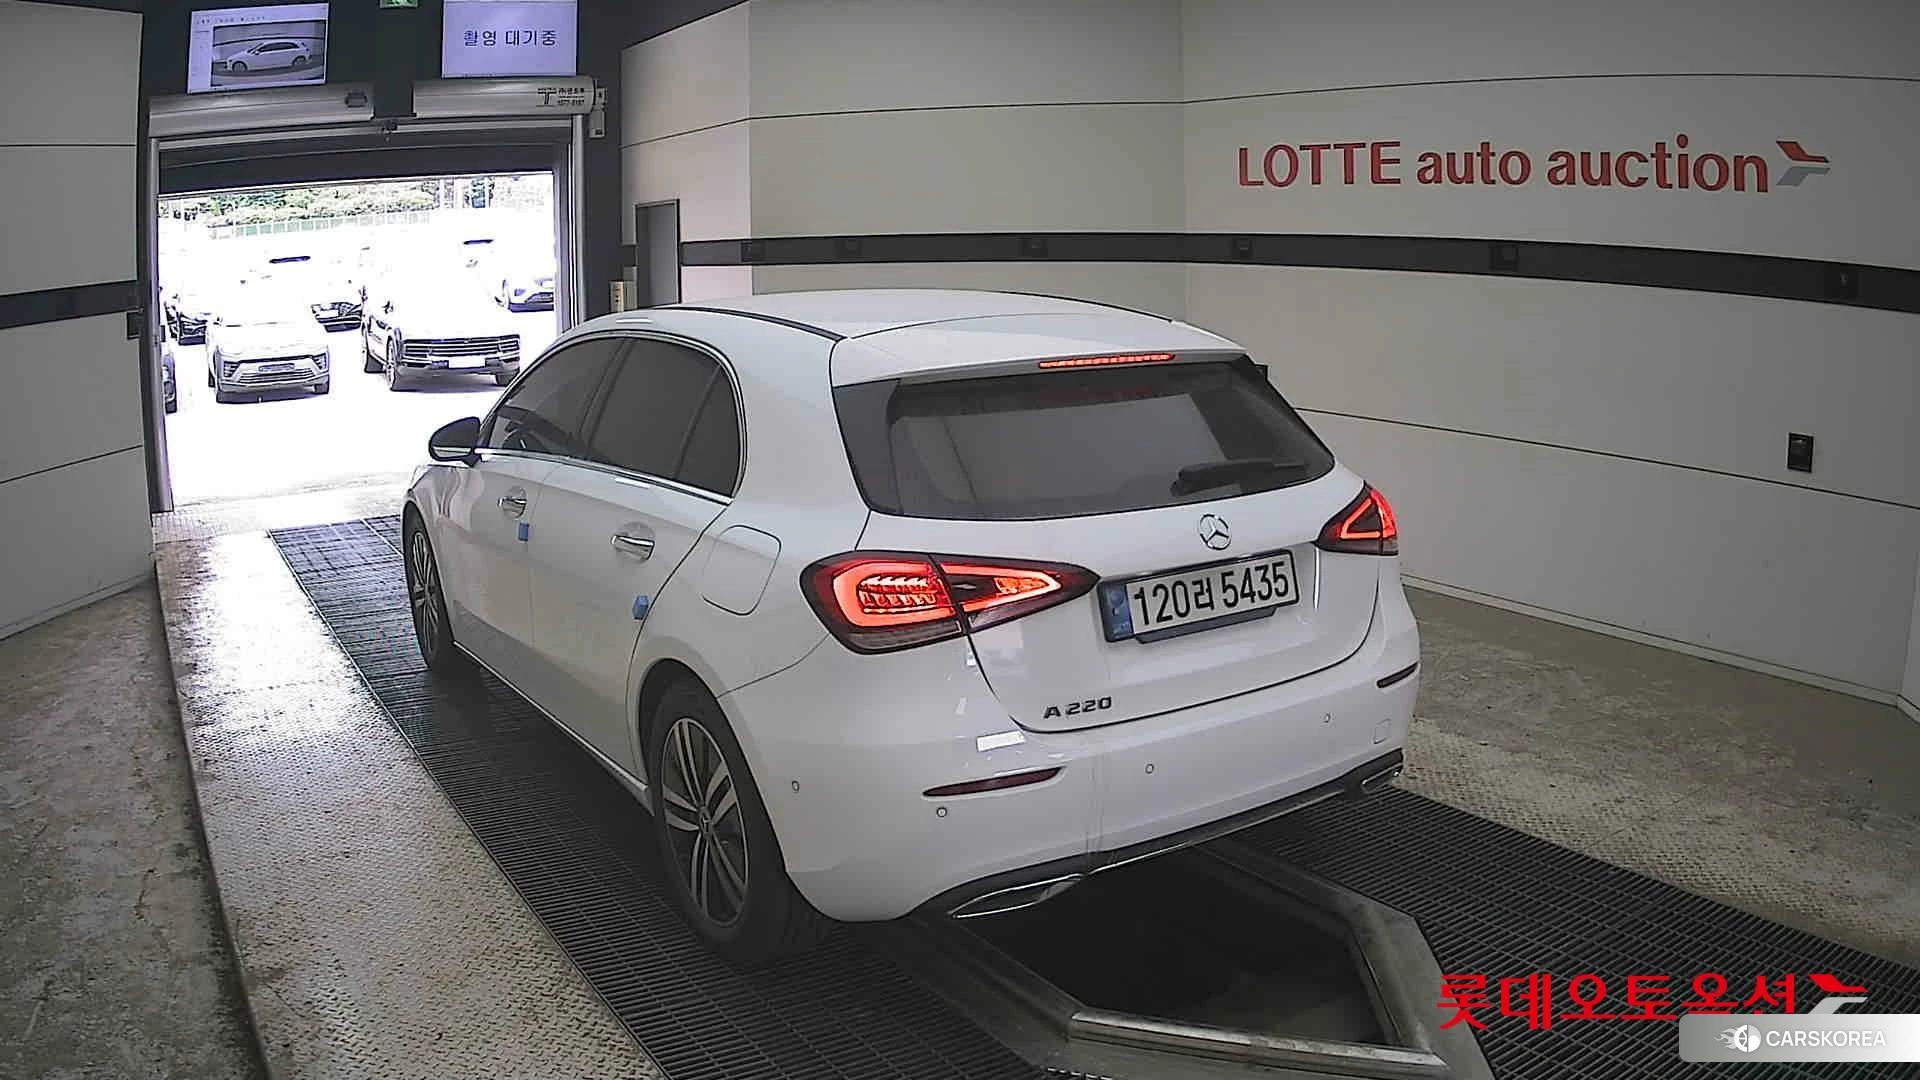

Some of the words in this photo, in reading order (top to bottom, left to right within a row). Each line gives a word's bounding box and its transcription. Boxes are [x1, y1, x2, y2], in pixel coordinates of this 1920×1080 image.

[463, 30, 497, 47] 촬영
[505, 30, 558, 47] 대기중
[1238, 140, 1402, 188] LOTTE
[1416, 141, 1532, 186] auto
[1547, 134, 1769, 193] auction
[1134, 576, 1215, 625] 120러
[1220, 561, 1289, 608] 5435
[1043, 706, 1061, 719] A
[1065, 696, 1112, 715] 220
